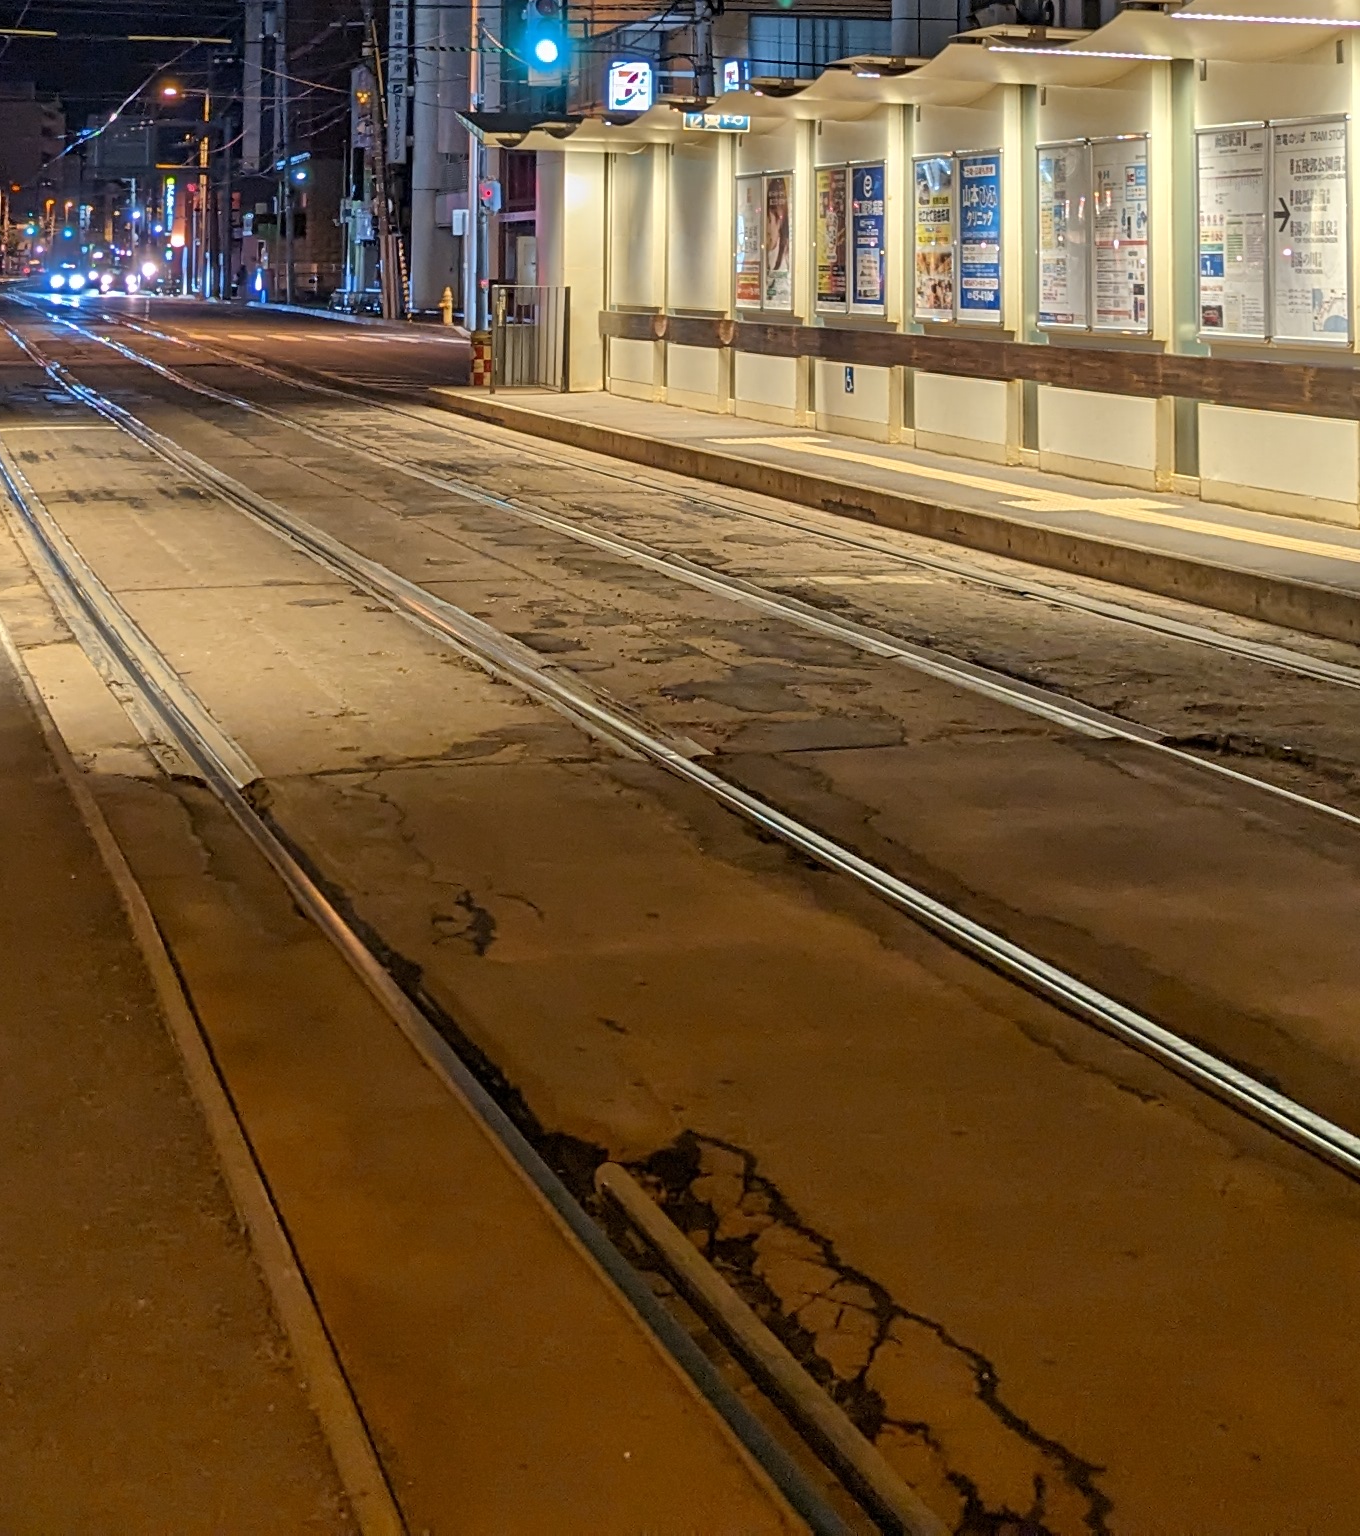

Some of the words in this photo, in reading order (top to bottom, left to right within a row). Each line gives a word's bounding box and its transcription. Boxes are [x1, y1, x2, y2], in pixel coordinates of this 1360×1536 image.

[966, 210, 993, 226] クリニック
